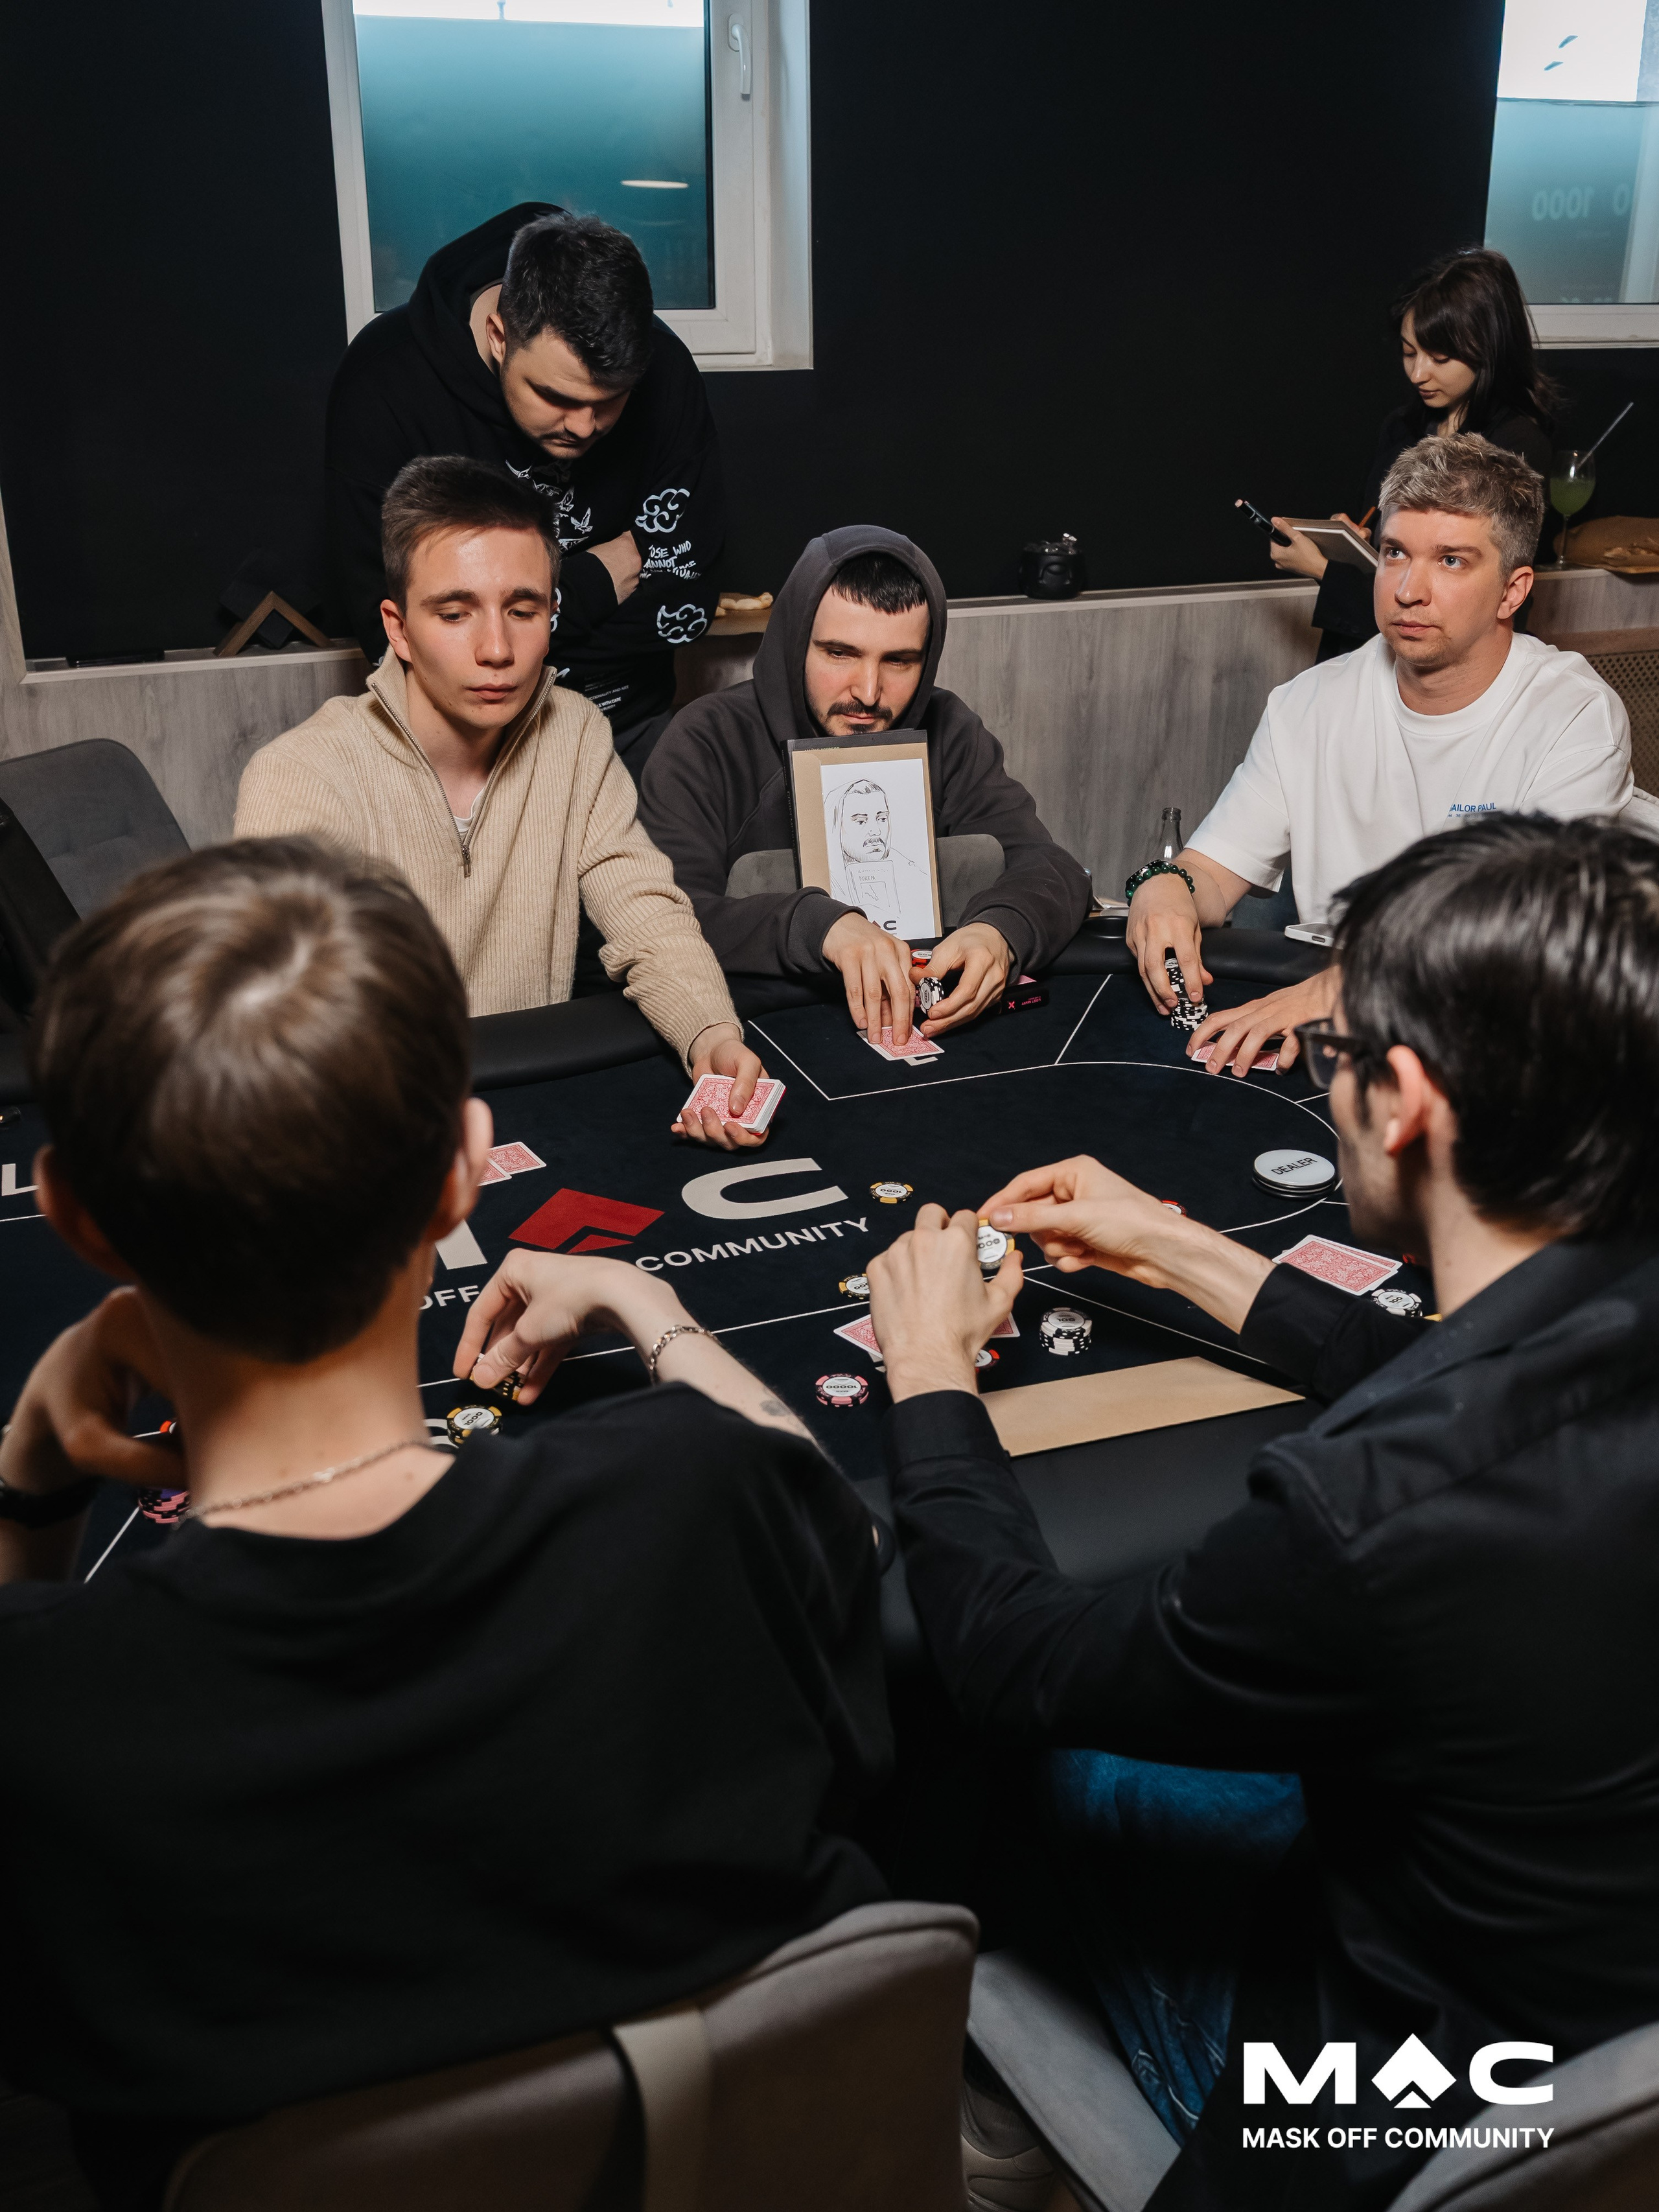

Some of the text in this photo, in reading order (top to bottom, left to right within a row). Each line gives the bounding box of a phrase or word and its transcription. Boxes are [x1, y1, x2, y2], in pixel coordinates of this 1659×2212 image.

[673, 541, 691, 556] WHO
[644, 556, 677, 568] ANNOT
[1478, 803, 1496, 812] PAUL
[1271, 1157, 1317, 1176] DEALER
[635, 1217, 870, 1272] COMMUNITY
[979, 1239, 1000, 1248] 000
[463, 1412, 483, 1426] 1000
